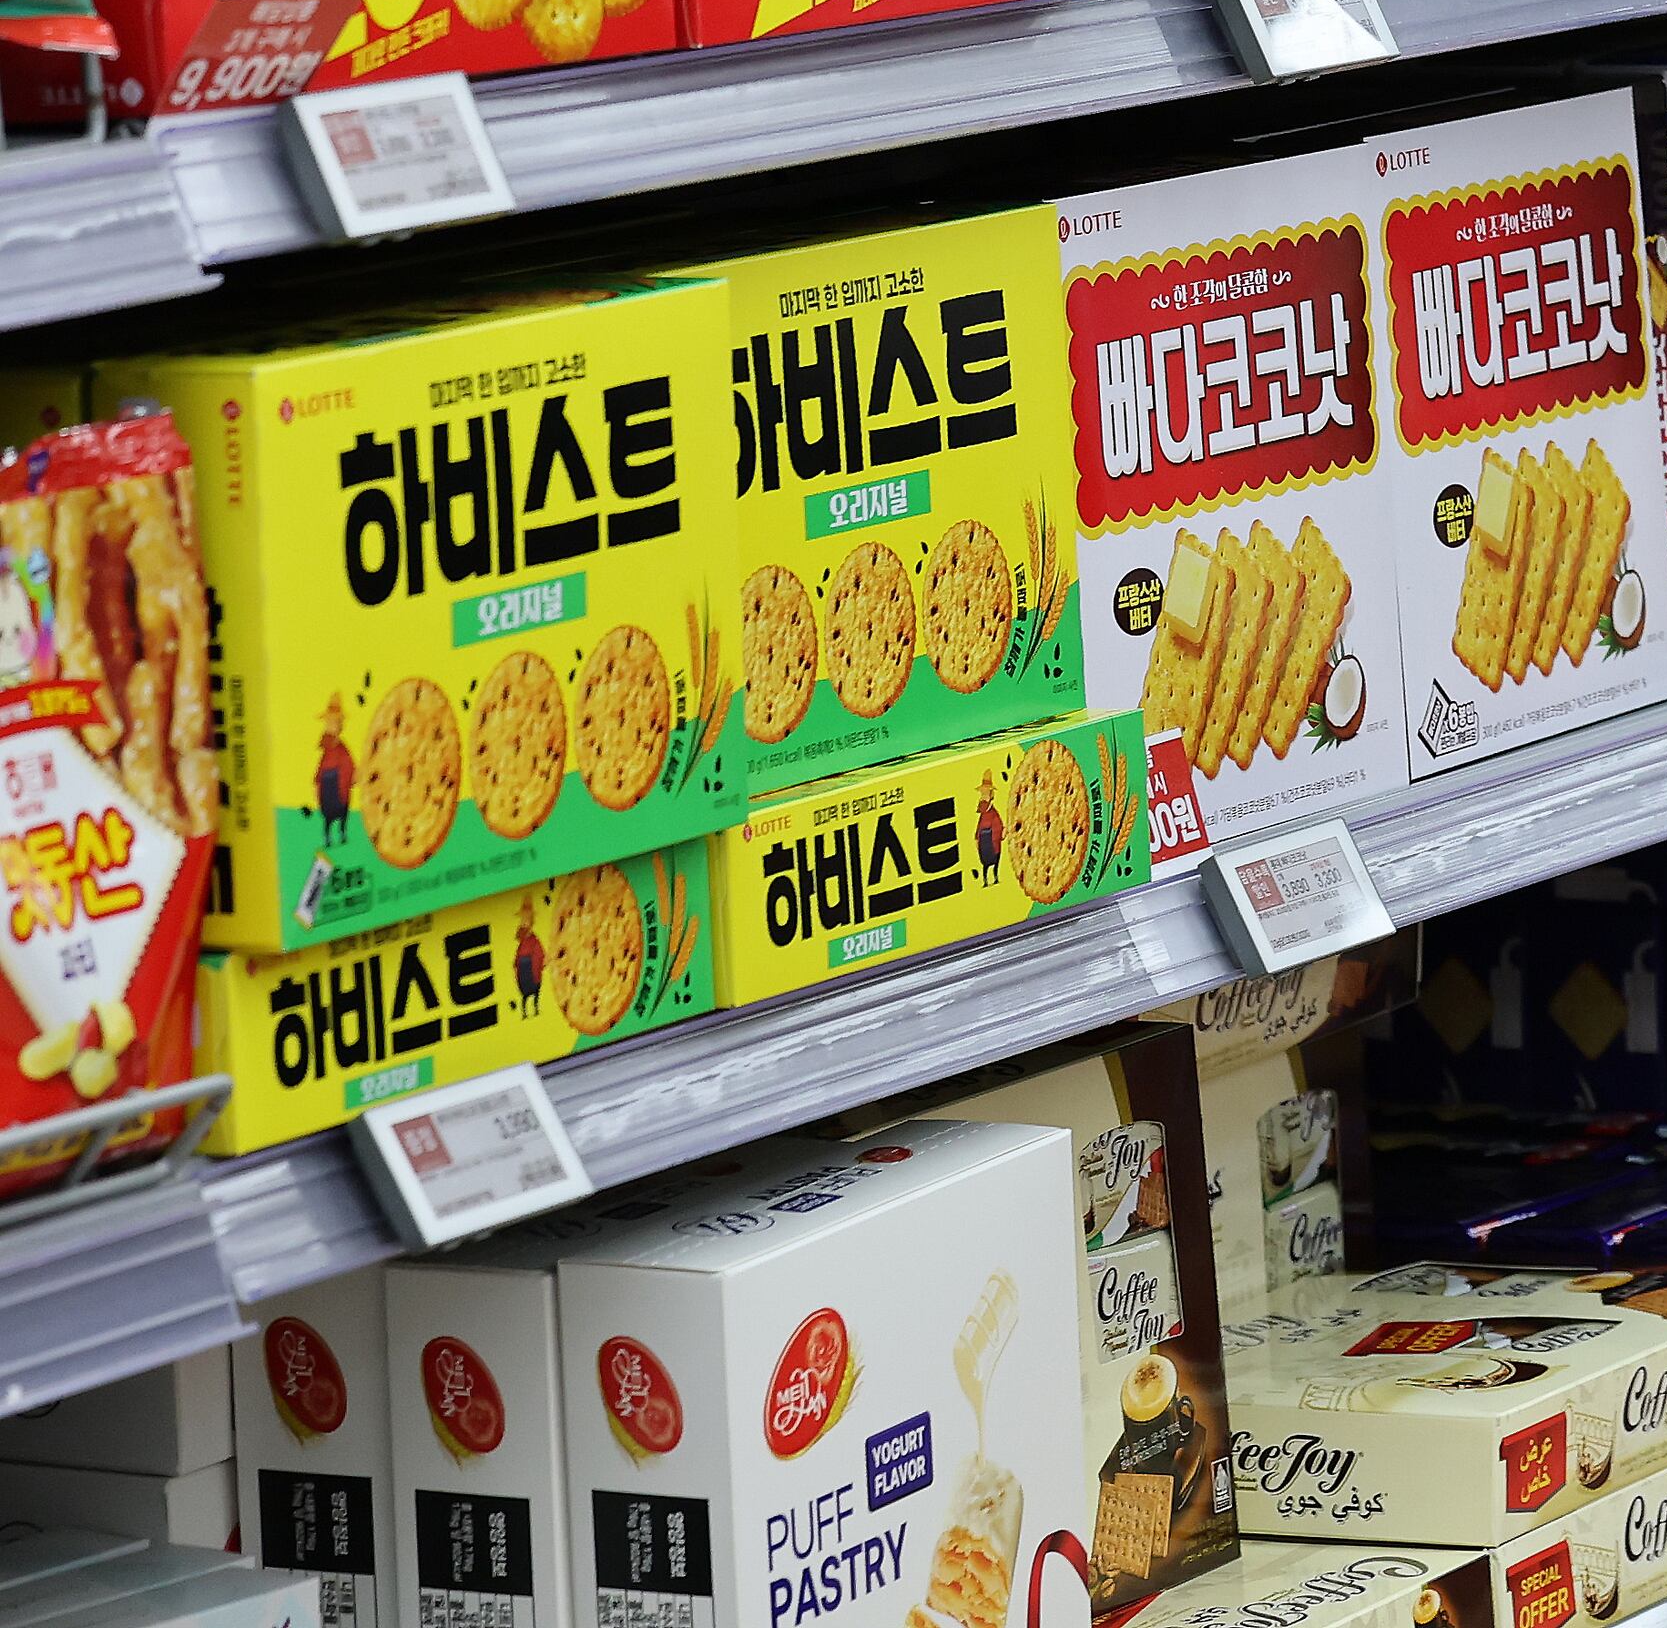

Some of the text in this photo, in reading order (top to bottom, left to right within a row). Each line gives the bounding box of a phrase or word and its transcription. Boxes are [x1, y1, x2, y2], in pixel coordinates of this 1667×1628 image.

[1390, 147, 1431, 173] LOTTE
[1073, 210, 1123, 237] LOTTE
[1473, 217, 1489, 244] 한
[1520, 204, 1554, 233] 달콤함
[778, 266, 925, 321] 마지막 한 입까지 고소한
[1172, 266, 1269, 311] 한 조각의 달콤함
[1412, 228, 1629, 401] 빠다코코낫
[732, 289, 1018, 500] 하비스트
[1096, 292, 1354, 480] 빠다코코낫
[339, 375, 681, 607] 하비스트
[828, 478, 909, 531] 오리지널
[1436, 496, 1474, 524] 프랑스산
[1445, 516, 1467, 544] 버터
[476, 580, 564, 638] 오리지널
[1117, 582, 1161, 610] 프랑스산
[1128, 603, 1152, 631] 버터
[753, 814, 793, 835] LOTTE
[762, 796, 963, 948] 하비스트
[842, 923, 894, 962] 오리지널
[266, 922, 501, 1089] 하비스트
[1106, 1135, 1147, 1190] Joy
[1098, 1266, 1158, 1325] Coffee
[1128, 1309, 1165, 1355] Joy
[871, 1425, 926, 1468] YOGURT
[1519, 1435, 1553, 1473] عرض
[874, 1454, 927, 1498] FLAVOR
[1519, 1465, 1552, 1504] خاص
[1276, 1485, 1386, 1524] كوفي جوي
[766, 1483, 854, 1573] PUFF
[769, 1521, 908, 1628] PASTRY
[1519, 1562, 1563, 1596] SPECIAL
[1518, 1586, 1571, 1628] OFFER
